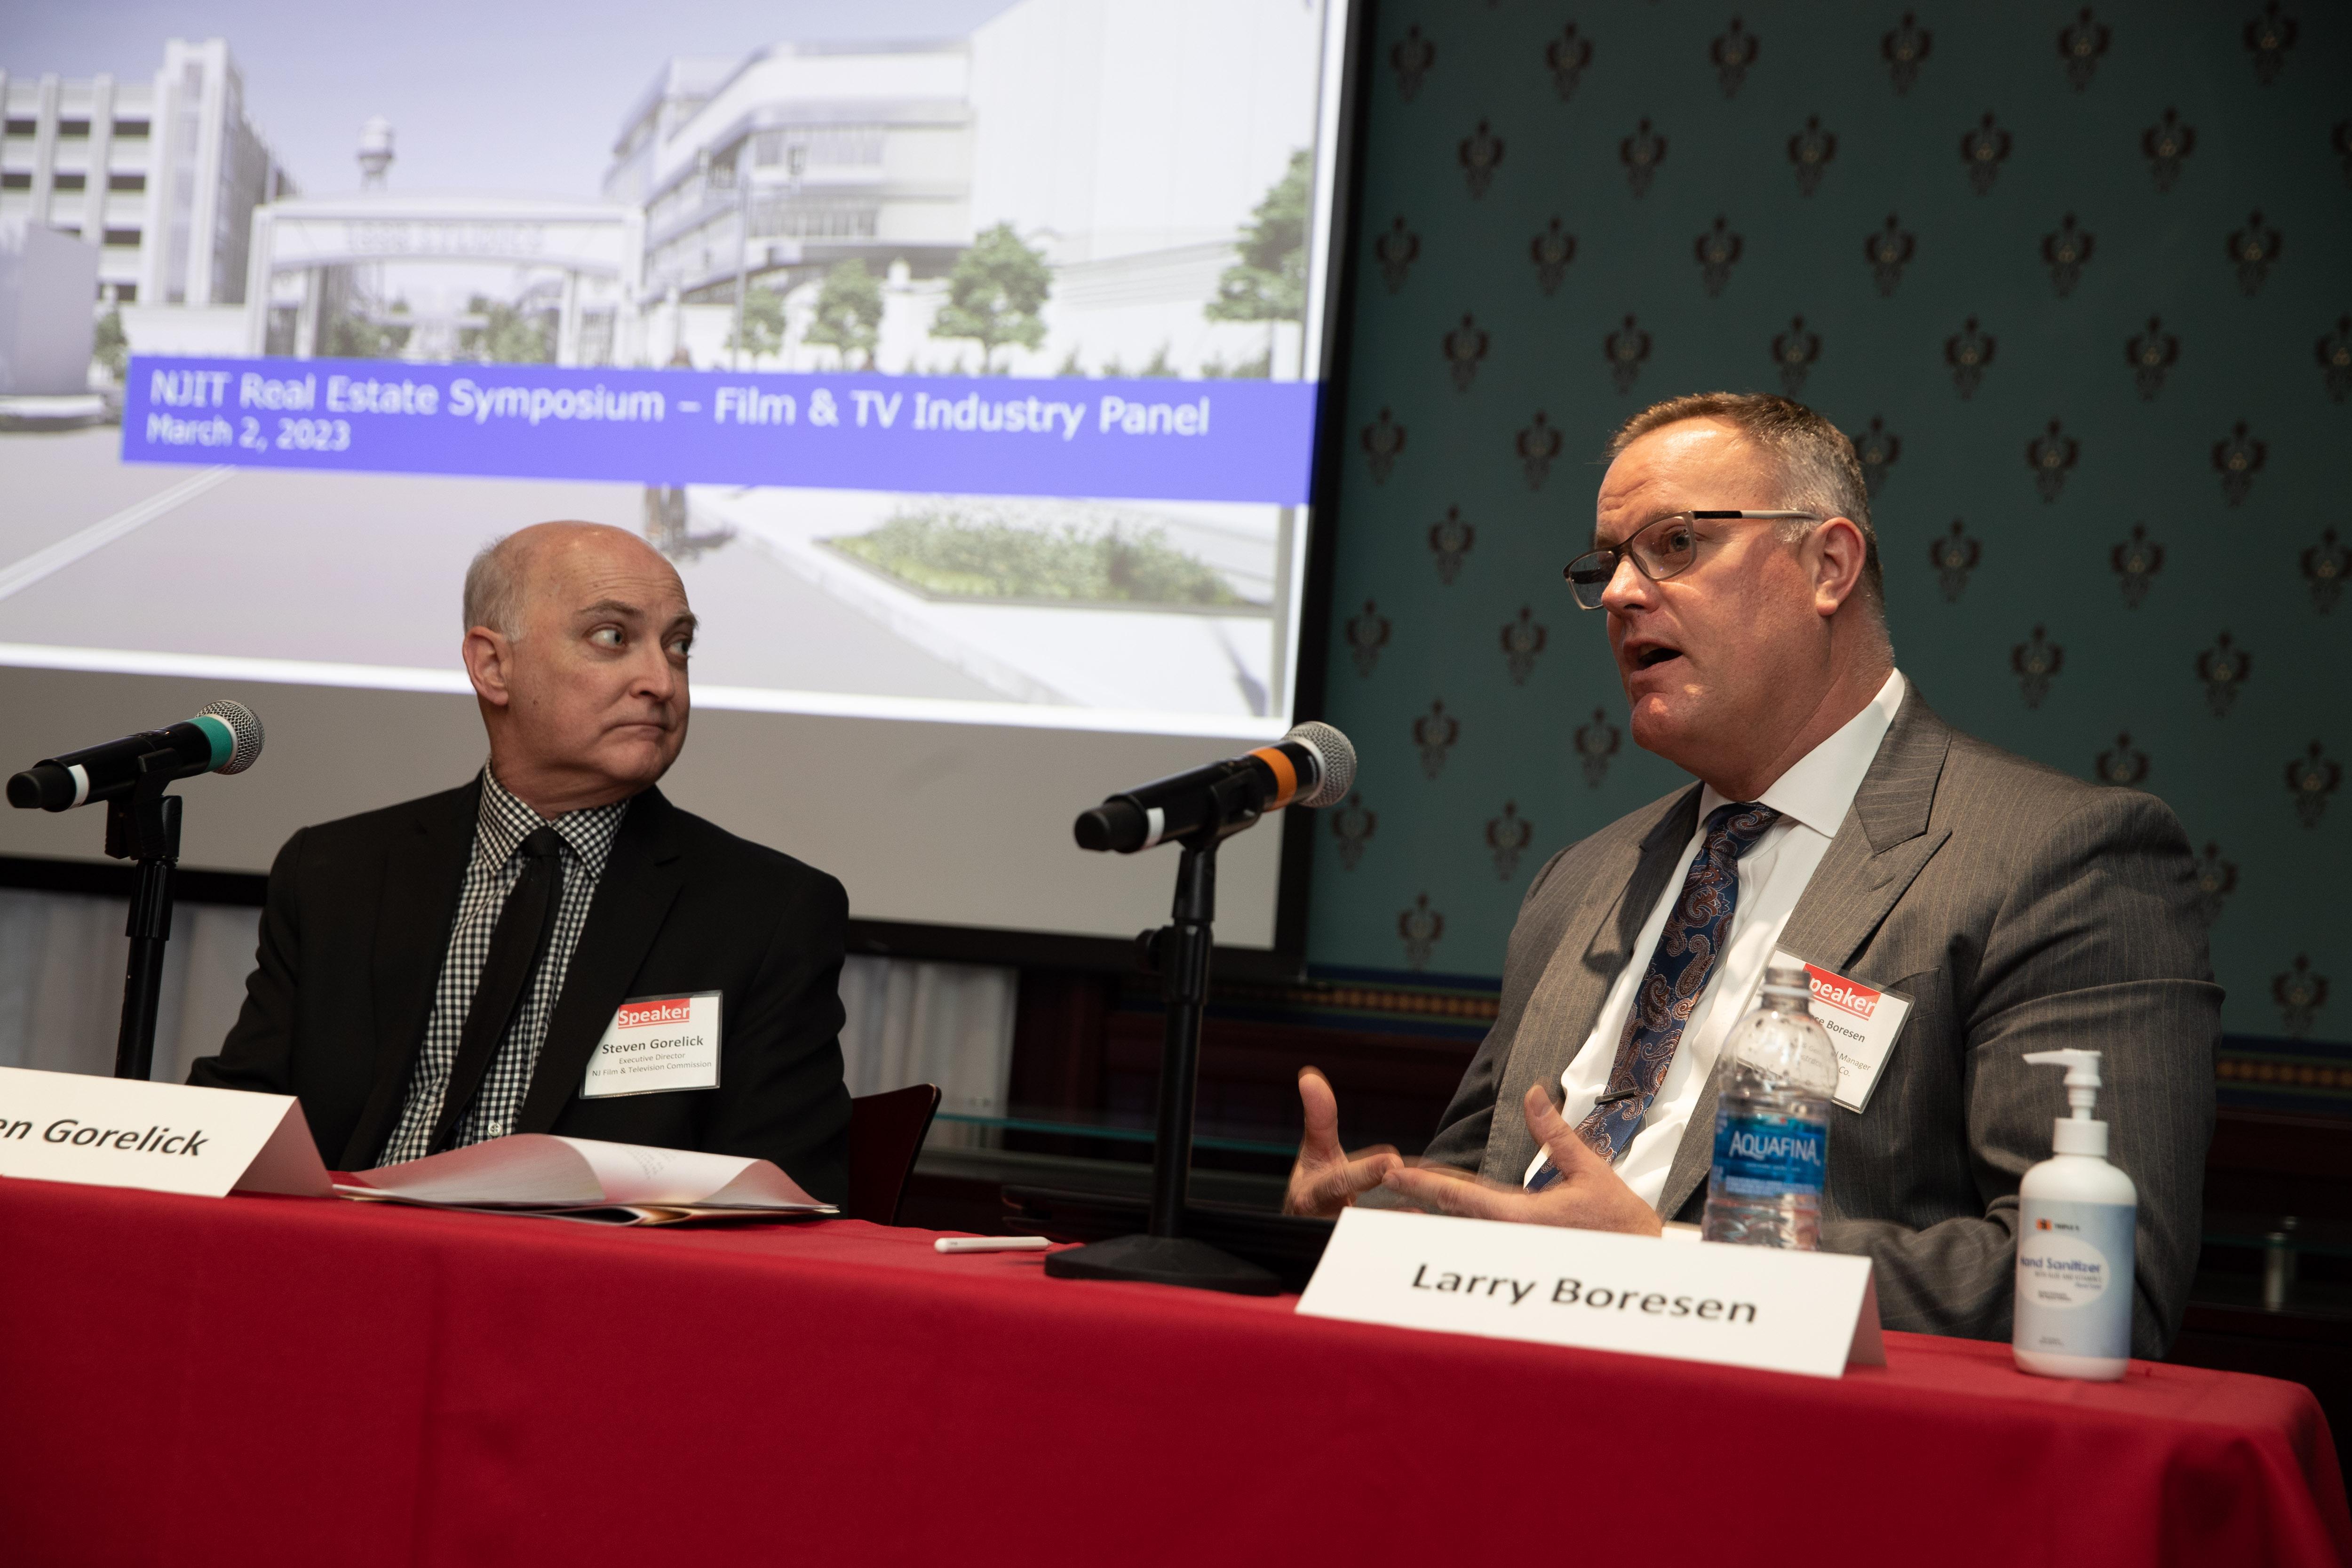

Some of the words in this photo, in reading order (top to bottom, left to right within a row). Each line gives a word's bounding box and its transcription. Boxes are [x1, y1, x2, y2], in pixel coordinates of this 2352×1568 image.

[151, 369, 232, 408] NJIT
[240, 372, 316, 411] Real
[327, 375, 439, 415] Estate
[448, 378, 664, 426] Symposium
[714, 387, 796, 425] Film
[808, 388, 840, 427] &
[850, 390, 902, 428] TV
[914, 391, 1086, 441] Industry
[1100, 395, 1210, 436] Panel
[146, 413, 233, 447] March
[239, 416, 268, 454] 2,
[276, 418, 351, 451] 2023
[1810, 977, 1876, 1014] peaker
[619, 1005, 690, 1025] Speaker
[1827, 1020, 1865, 1043] Boresen
[602, 1041, 646, 1054] Steven
[650, 1035, 704, 1049] Gorelick
[619, 1055, 653, 1064] Executive
[655, 1052, 685, 1062] Director
[629, 1064, 665, 1073] Television
[667, 1061, 712, 1070] Commission
[1839, 1053, 1871, 1071] Manager
[1839, 1066, 1850, 1077] Co.
[43, 1119, 210, 1156] Gorelick
[1728, 1130, 1819, 1164] AQUAFINA
[1410, 1263, 1537, 1306] Larry
[1551, 1277, 1757, 1324] Boresen
